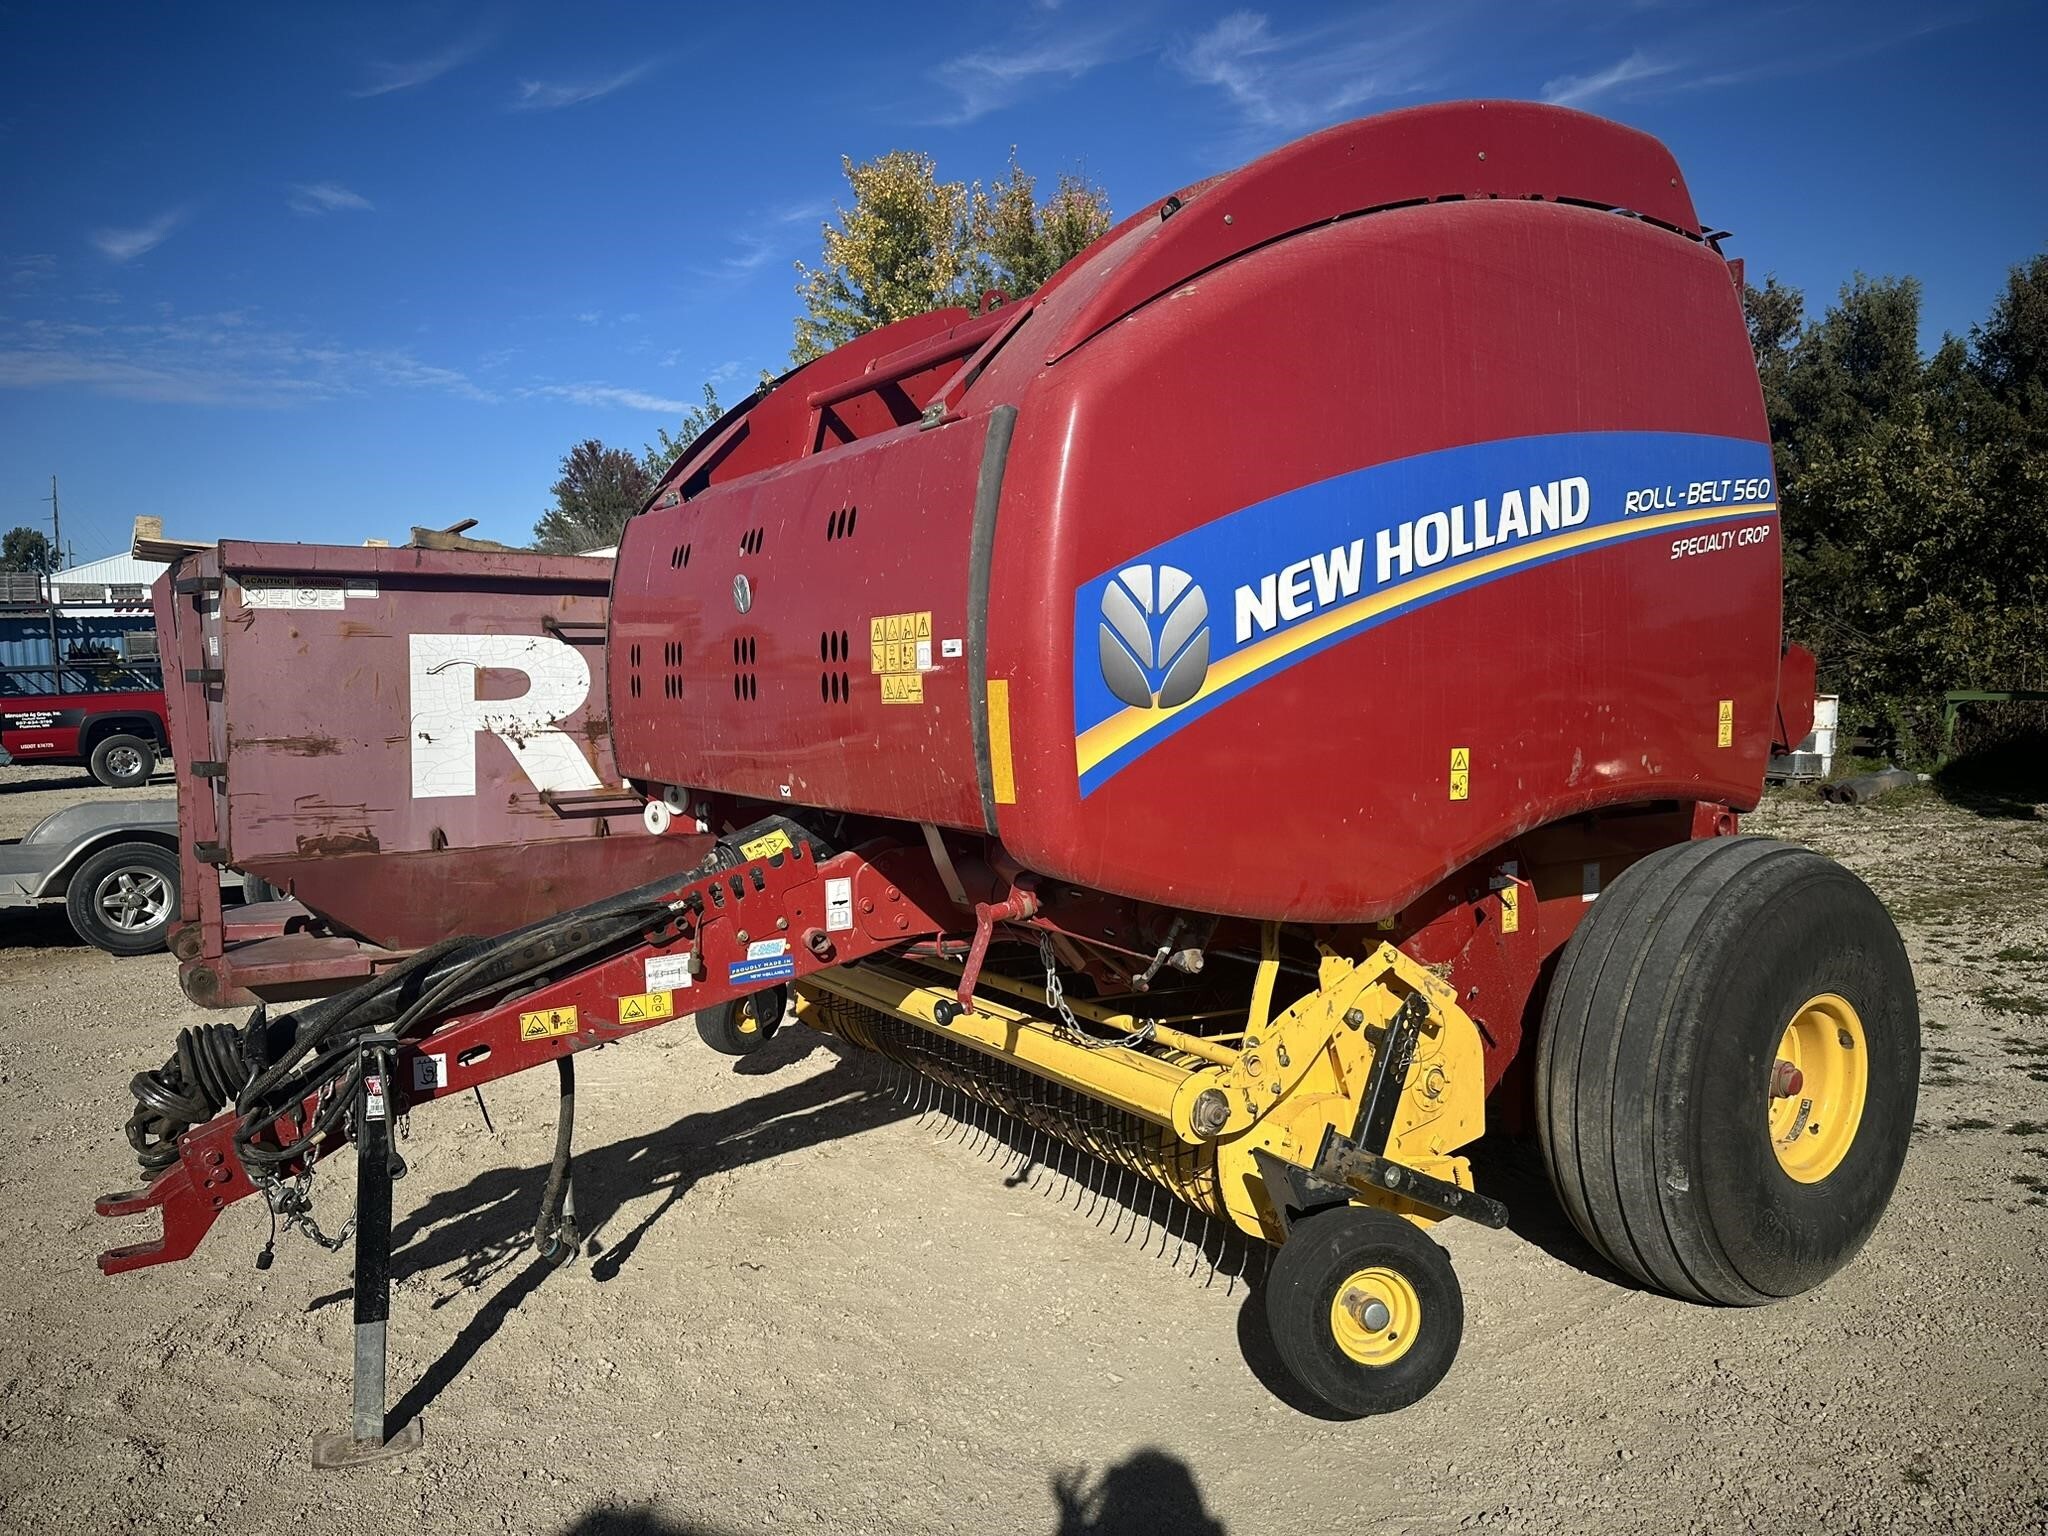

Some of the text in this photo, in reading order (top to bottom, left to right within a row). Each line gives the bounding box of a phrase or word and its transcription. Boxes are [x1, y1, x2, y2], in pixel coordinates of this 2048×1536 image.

[1625, 478, 1770, 515] ROLL-BELT 560
[1671, 525, 1770, 559] SPECIALTY CROP
[1235, 476, 1590, 644] NEW HOLLAND
[250, 577, 290, 585] CAUTION
[409, 634, 604, 798] R
[732, 964, 761, 974] PROUDLY
